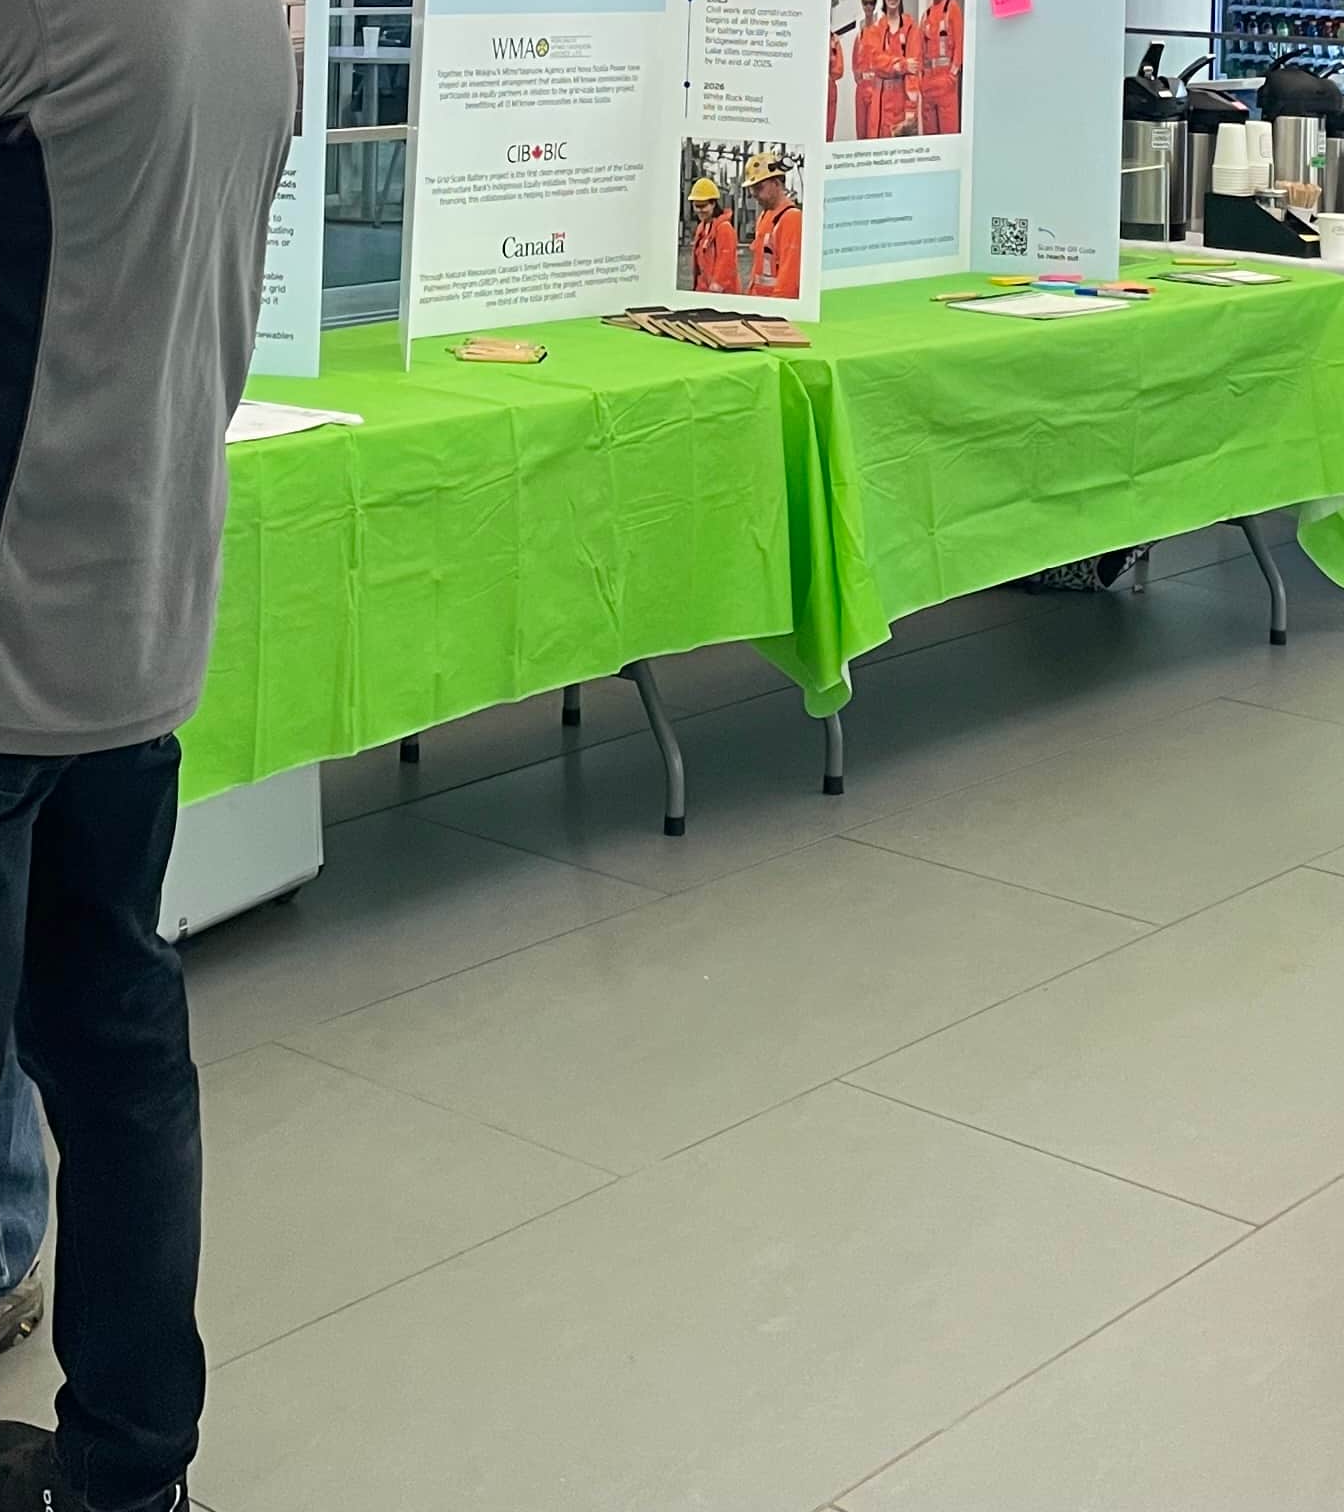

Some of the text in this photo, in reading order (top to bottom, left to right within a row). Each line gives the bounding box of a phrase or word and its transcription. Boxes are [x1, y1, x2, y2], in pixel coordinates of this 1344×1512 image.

[491, 37, 536, 60] WMA
[506, 141, 568, 163] CIB BIC
[502, 232, 565, 259] Canada
